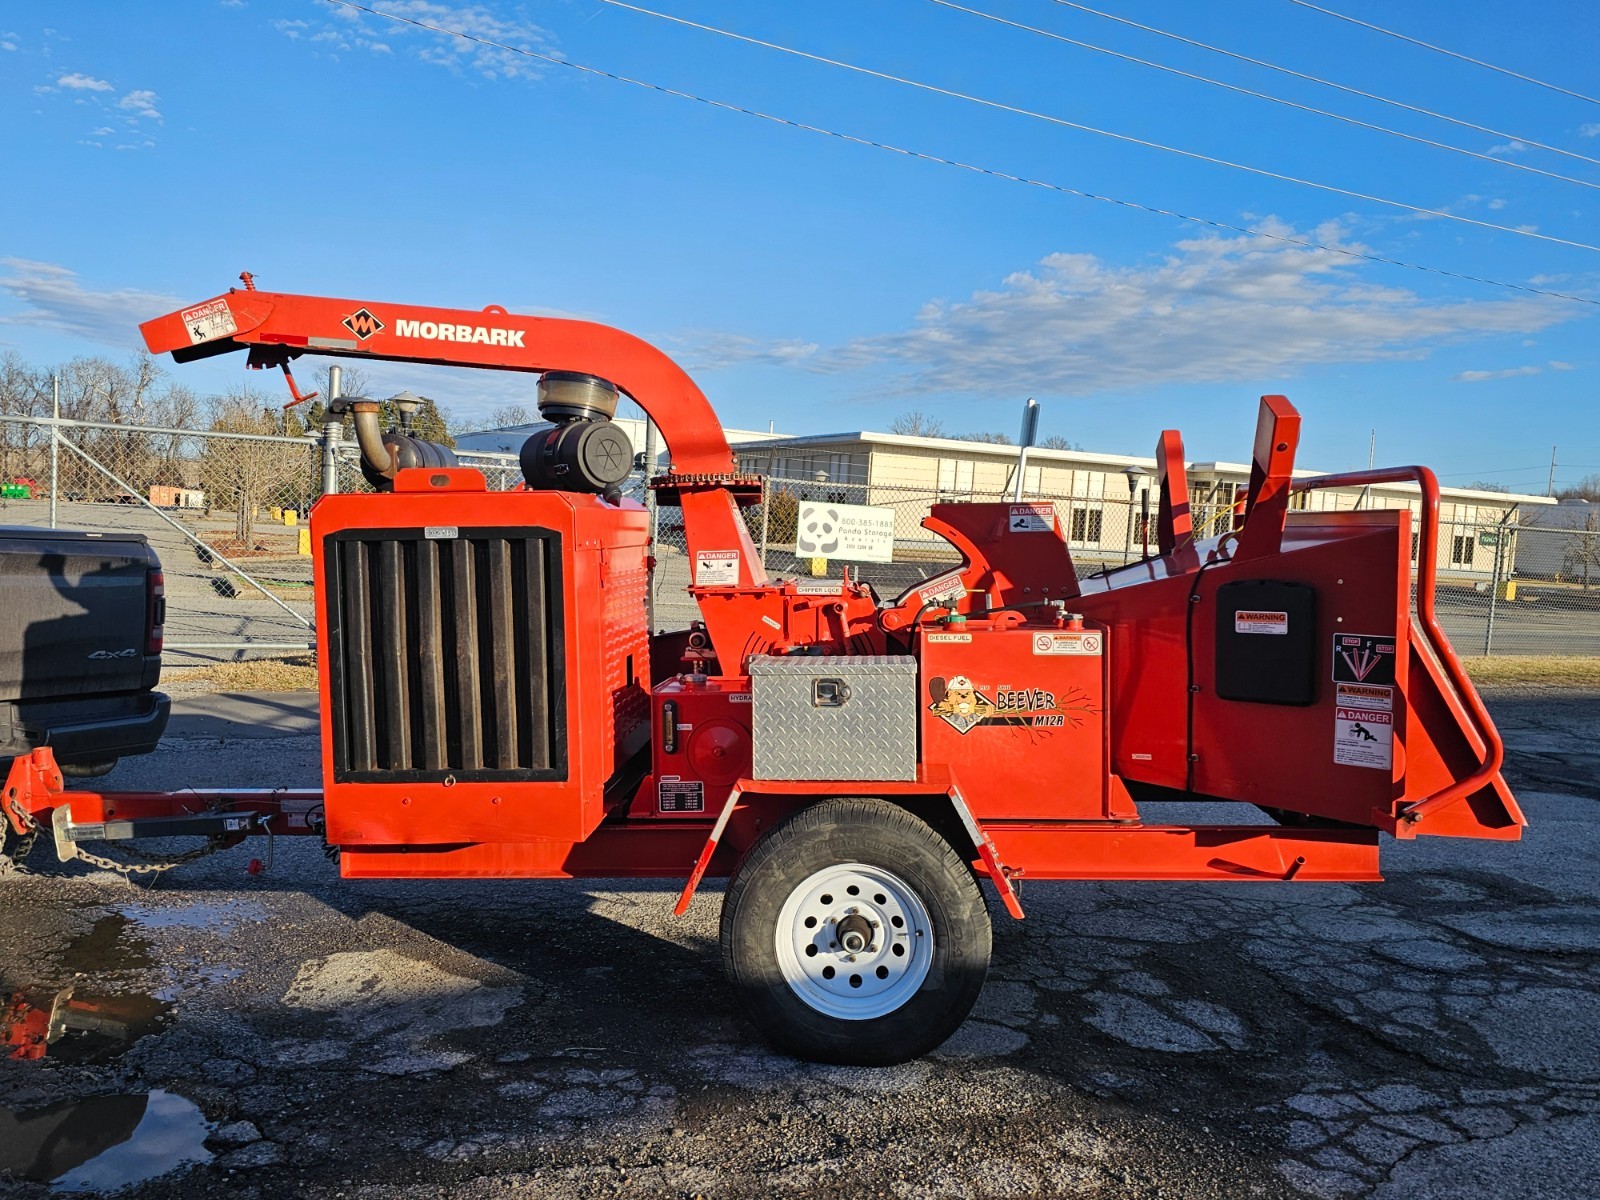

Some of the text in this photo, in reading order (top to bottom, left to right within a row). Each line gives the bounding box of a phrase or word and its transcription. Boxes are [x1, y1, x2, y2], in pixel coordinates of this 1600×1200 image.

[395, 319, 526, 348] MORBARK
[838, 526, 892, 538] Panda Storage
[928, 578, 959, 595] DANGER
[1246, 613, 1285, 621] WARNING
[1347, 686, 1390, 697] WARNING
[996, 687, 1056, 711] BEEVER
[1034, 715, 1065, 726] M12R
[1347, 711, 1390, 723] DANGER
